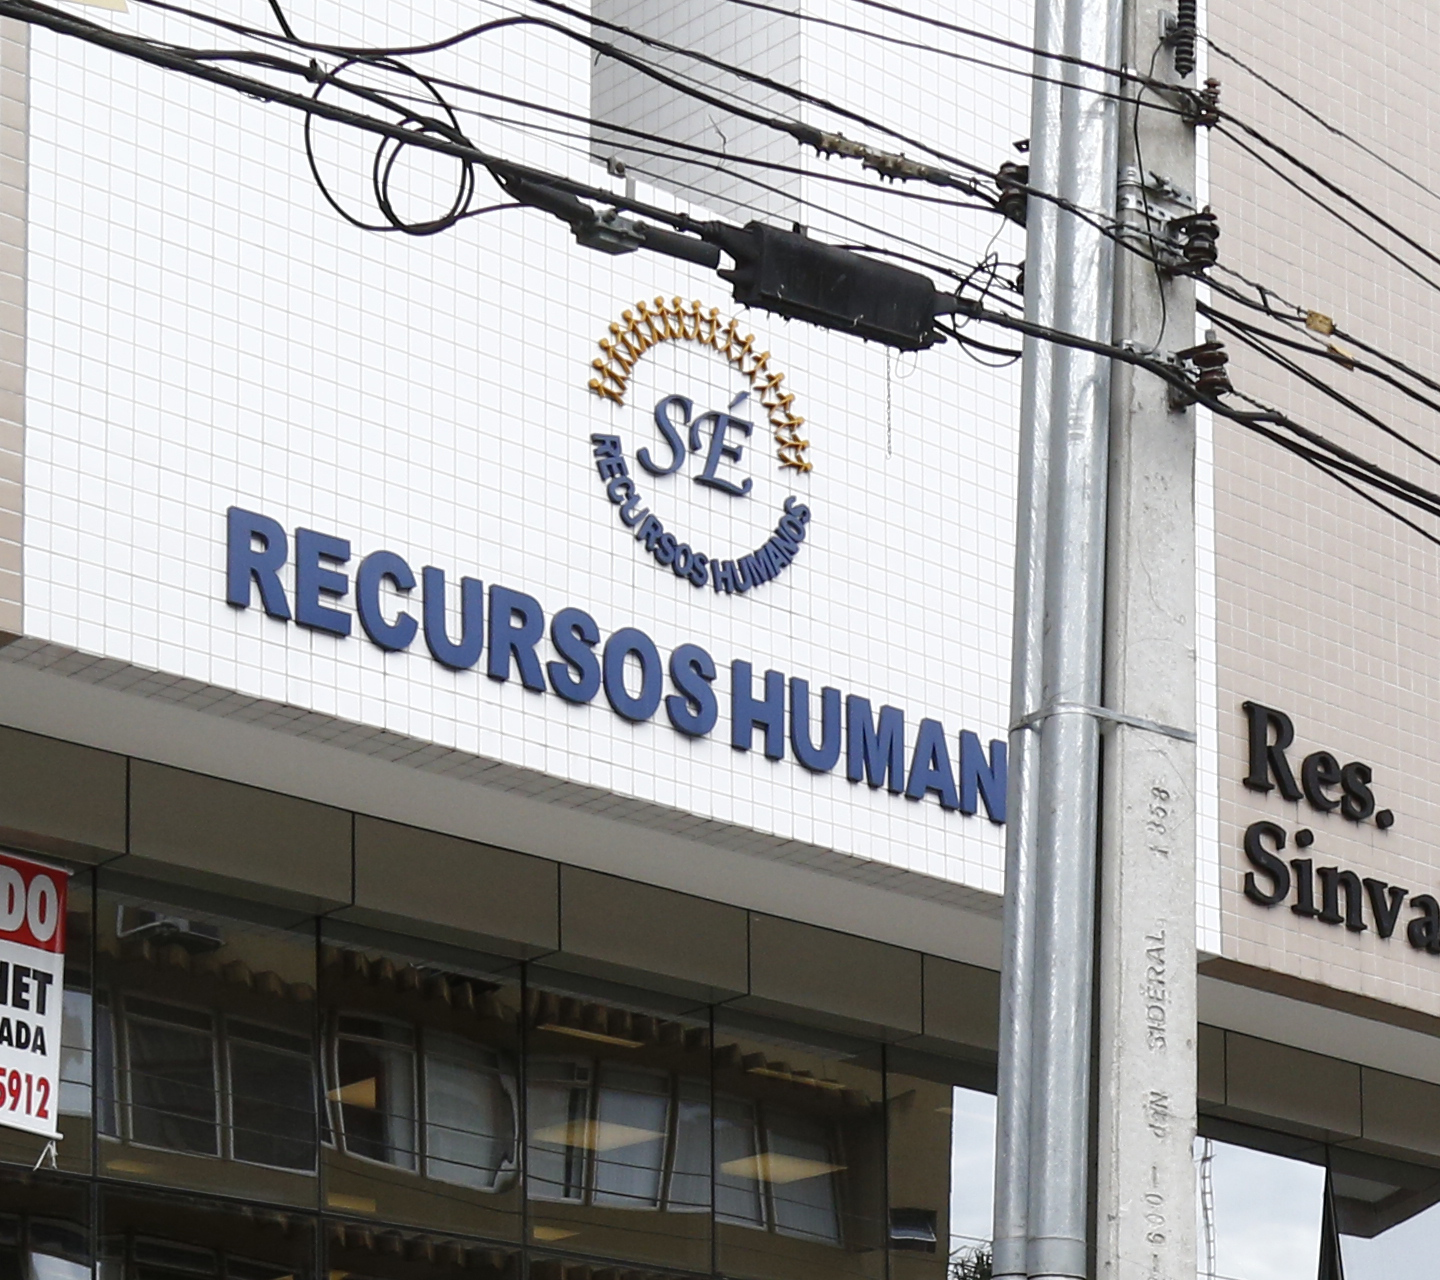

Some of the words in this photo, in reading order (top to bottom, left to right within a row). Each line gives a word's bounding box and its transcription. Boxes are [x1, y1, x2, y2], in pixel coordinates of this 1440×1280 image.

[592, 432, 709, 590] RECURSOS
[711, 494, 811, 595] HUMANOS
[225, 506, 718, 738] RECURSOS
[730, 659, 1007, 825] HUMAN
[1242, 700, 1394, 830] Res.
